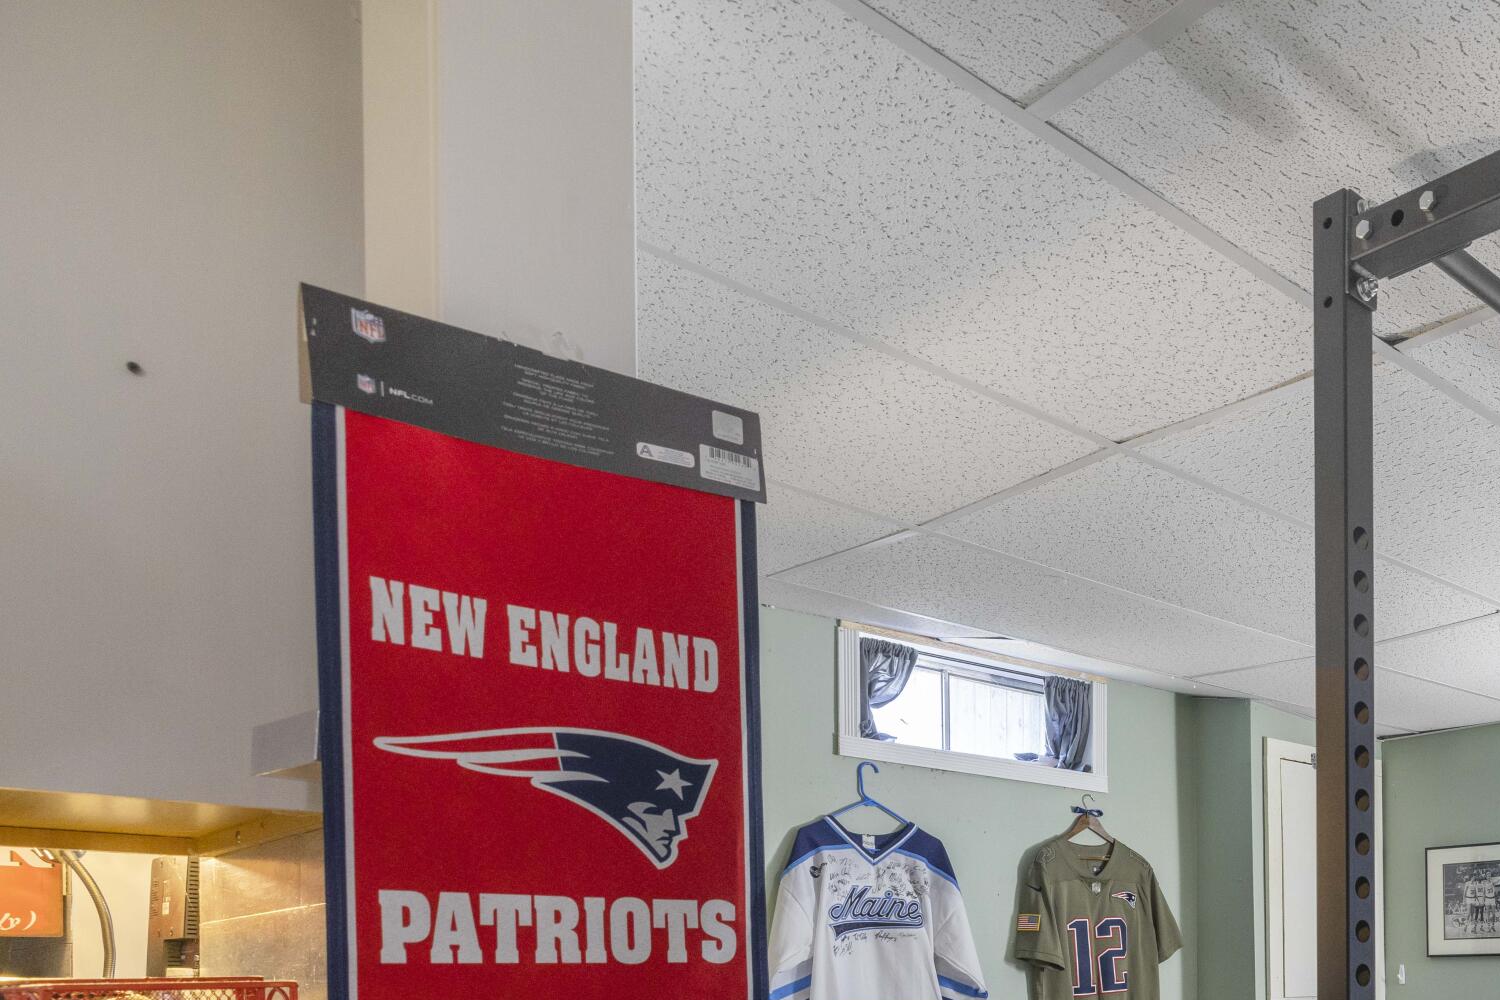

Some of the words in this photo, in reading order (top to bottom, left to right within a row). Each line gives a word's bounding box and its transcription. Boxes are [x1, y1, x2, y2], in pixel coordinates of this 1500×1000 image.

[369, 575, 487, 658] NEW
[506, 604, 720, 693] ENGLAND
[377, 888, 738, 965] PATRIOTS
[828, 884, 924, 922] Maine
[1067, 916, 1129, 996] 12
